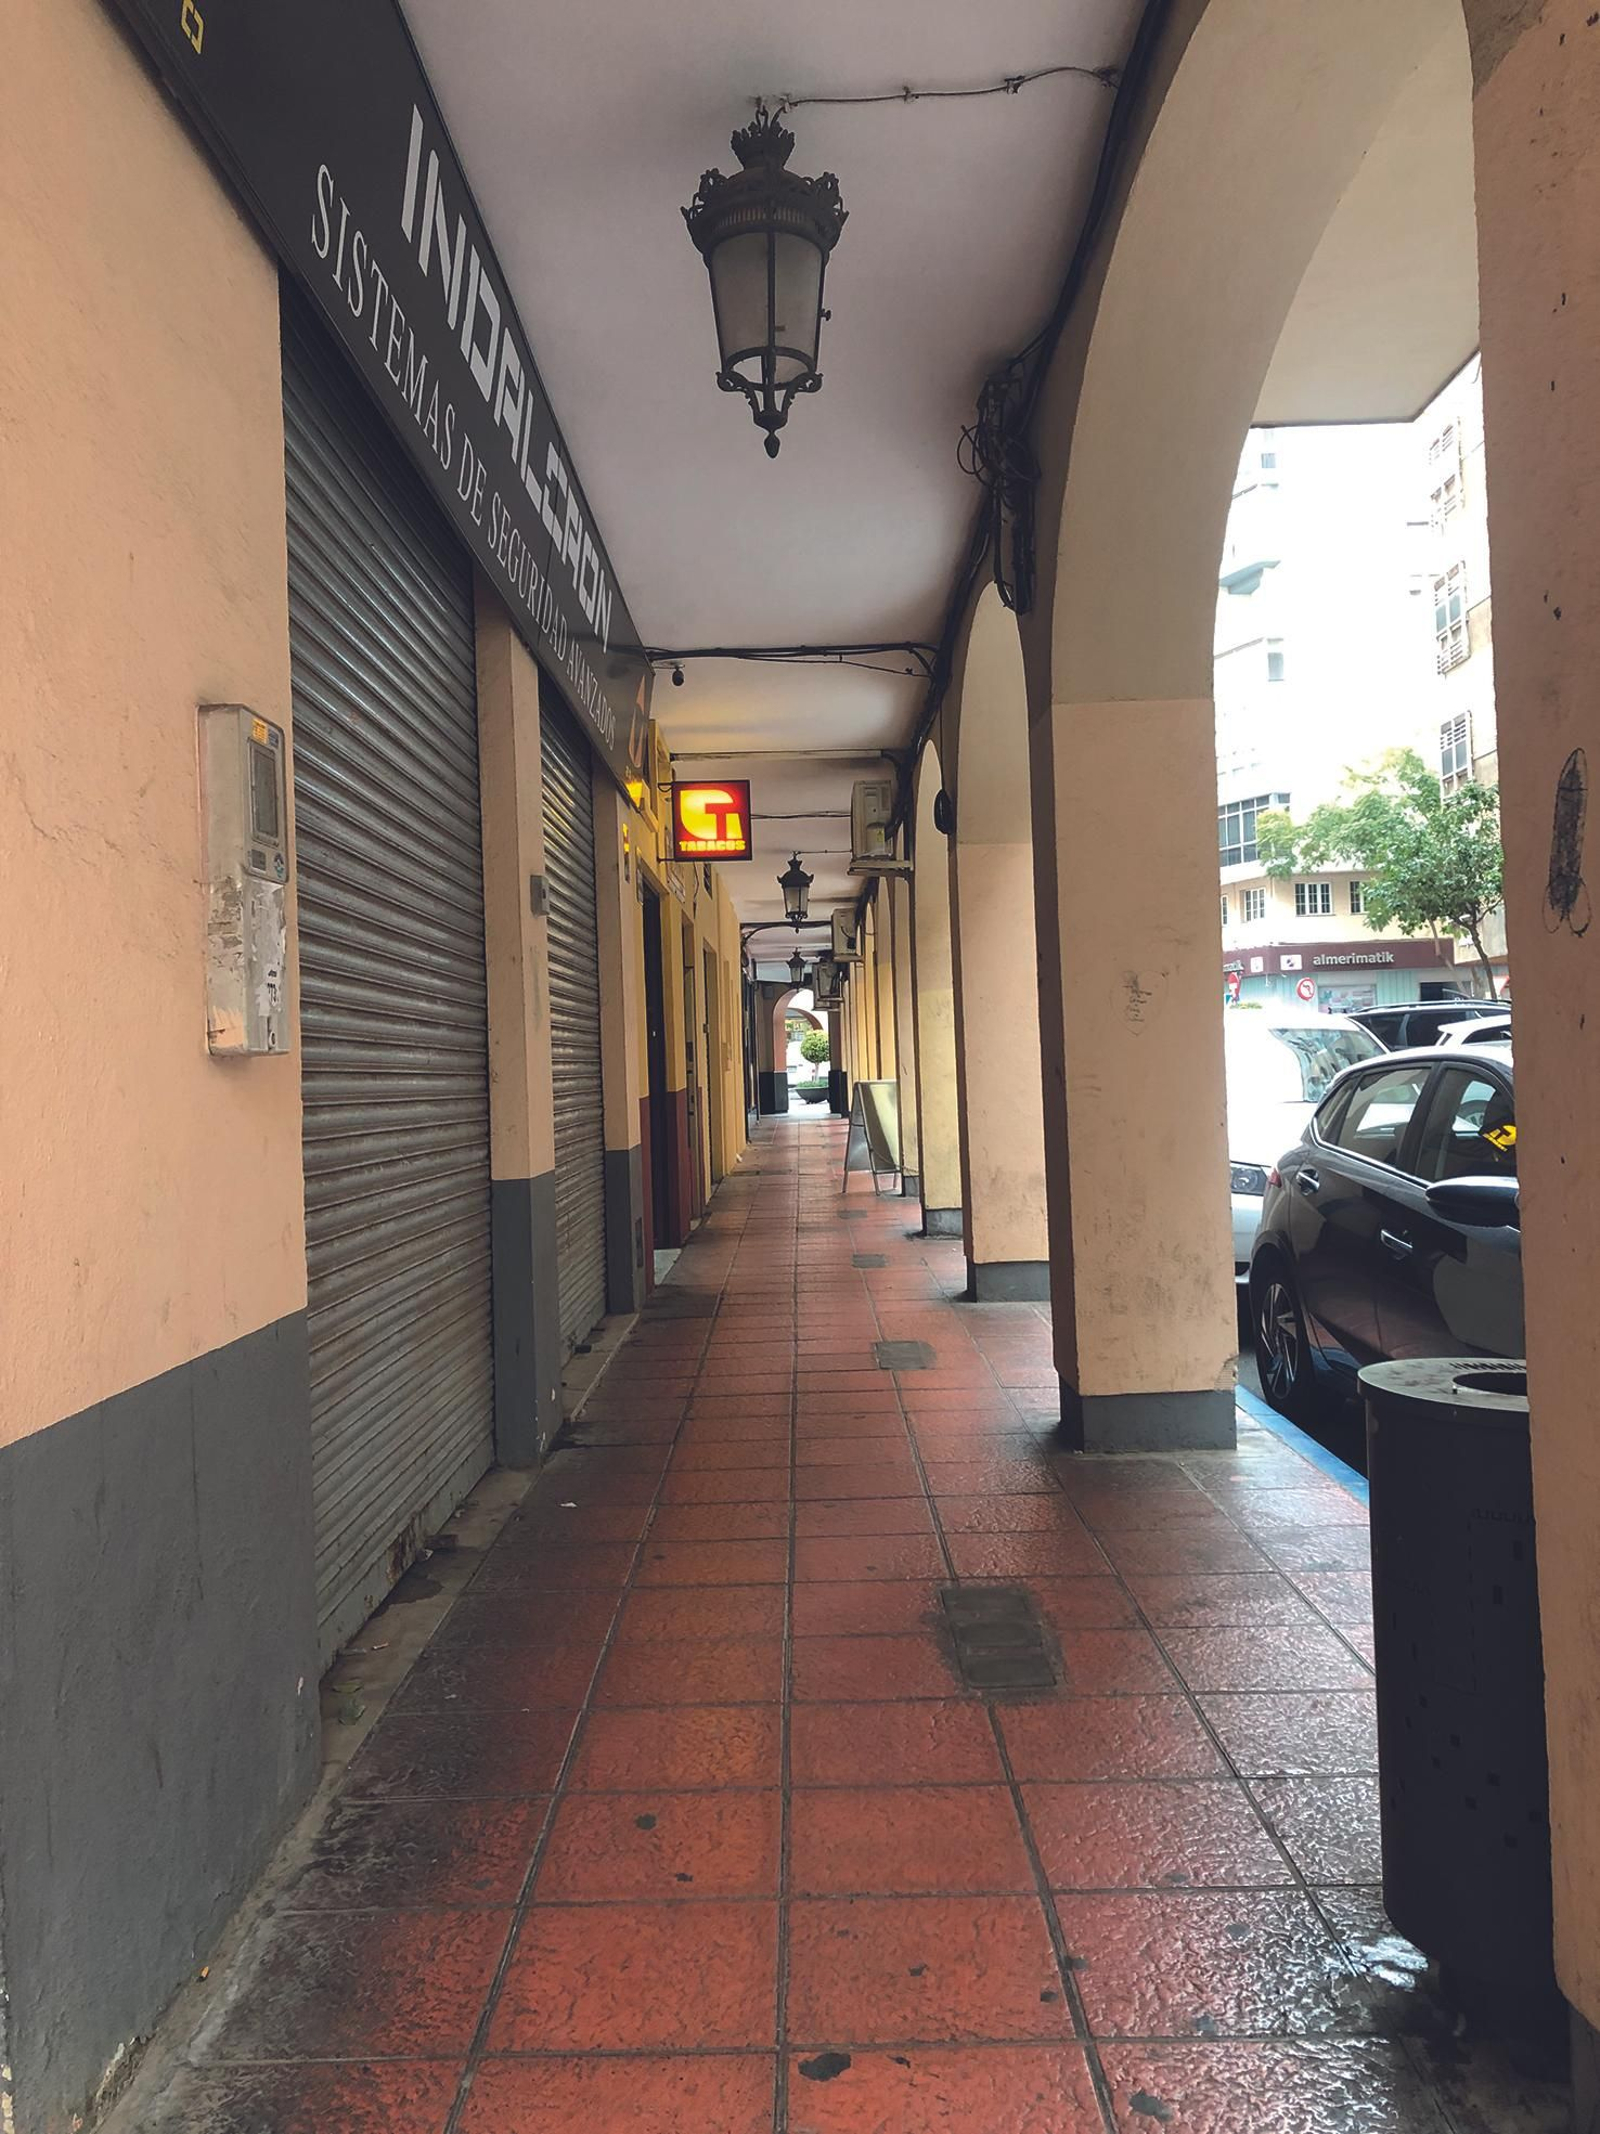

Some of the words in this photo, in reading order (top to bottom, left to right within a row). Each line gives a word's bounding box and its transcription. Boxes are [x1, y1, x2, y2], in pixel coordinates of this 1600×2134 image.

[311, 164, 455, 471] SISTEMAS
[457, 432, 487, 527] DE
[488, 491, 568, 662] SEGURIDAD
[566, 637, 616, 751] AVANZADOS
[679, 839, 746, 852] TABACOS
[1312, 951, 1395, 966] almerimatik
